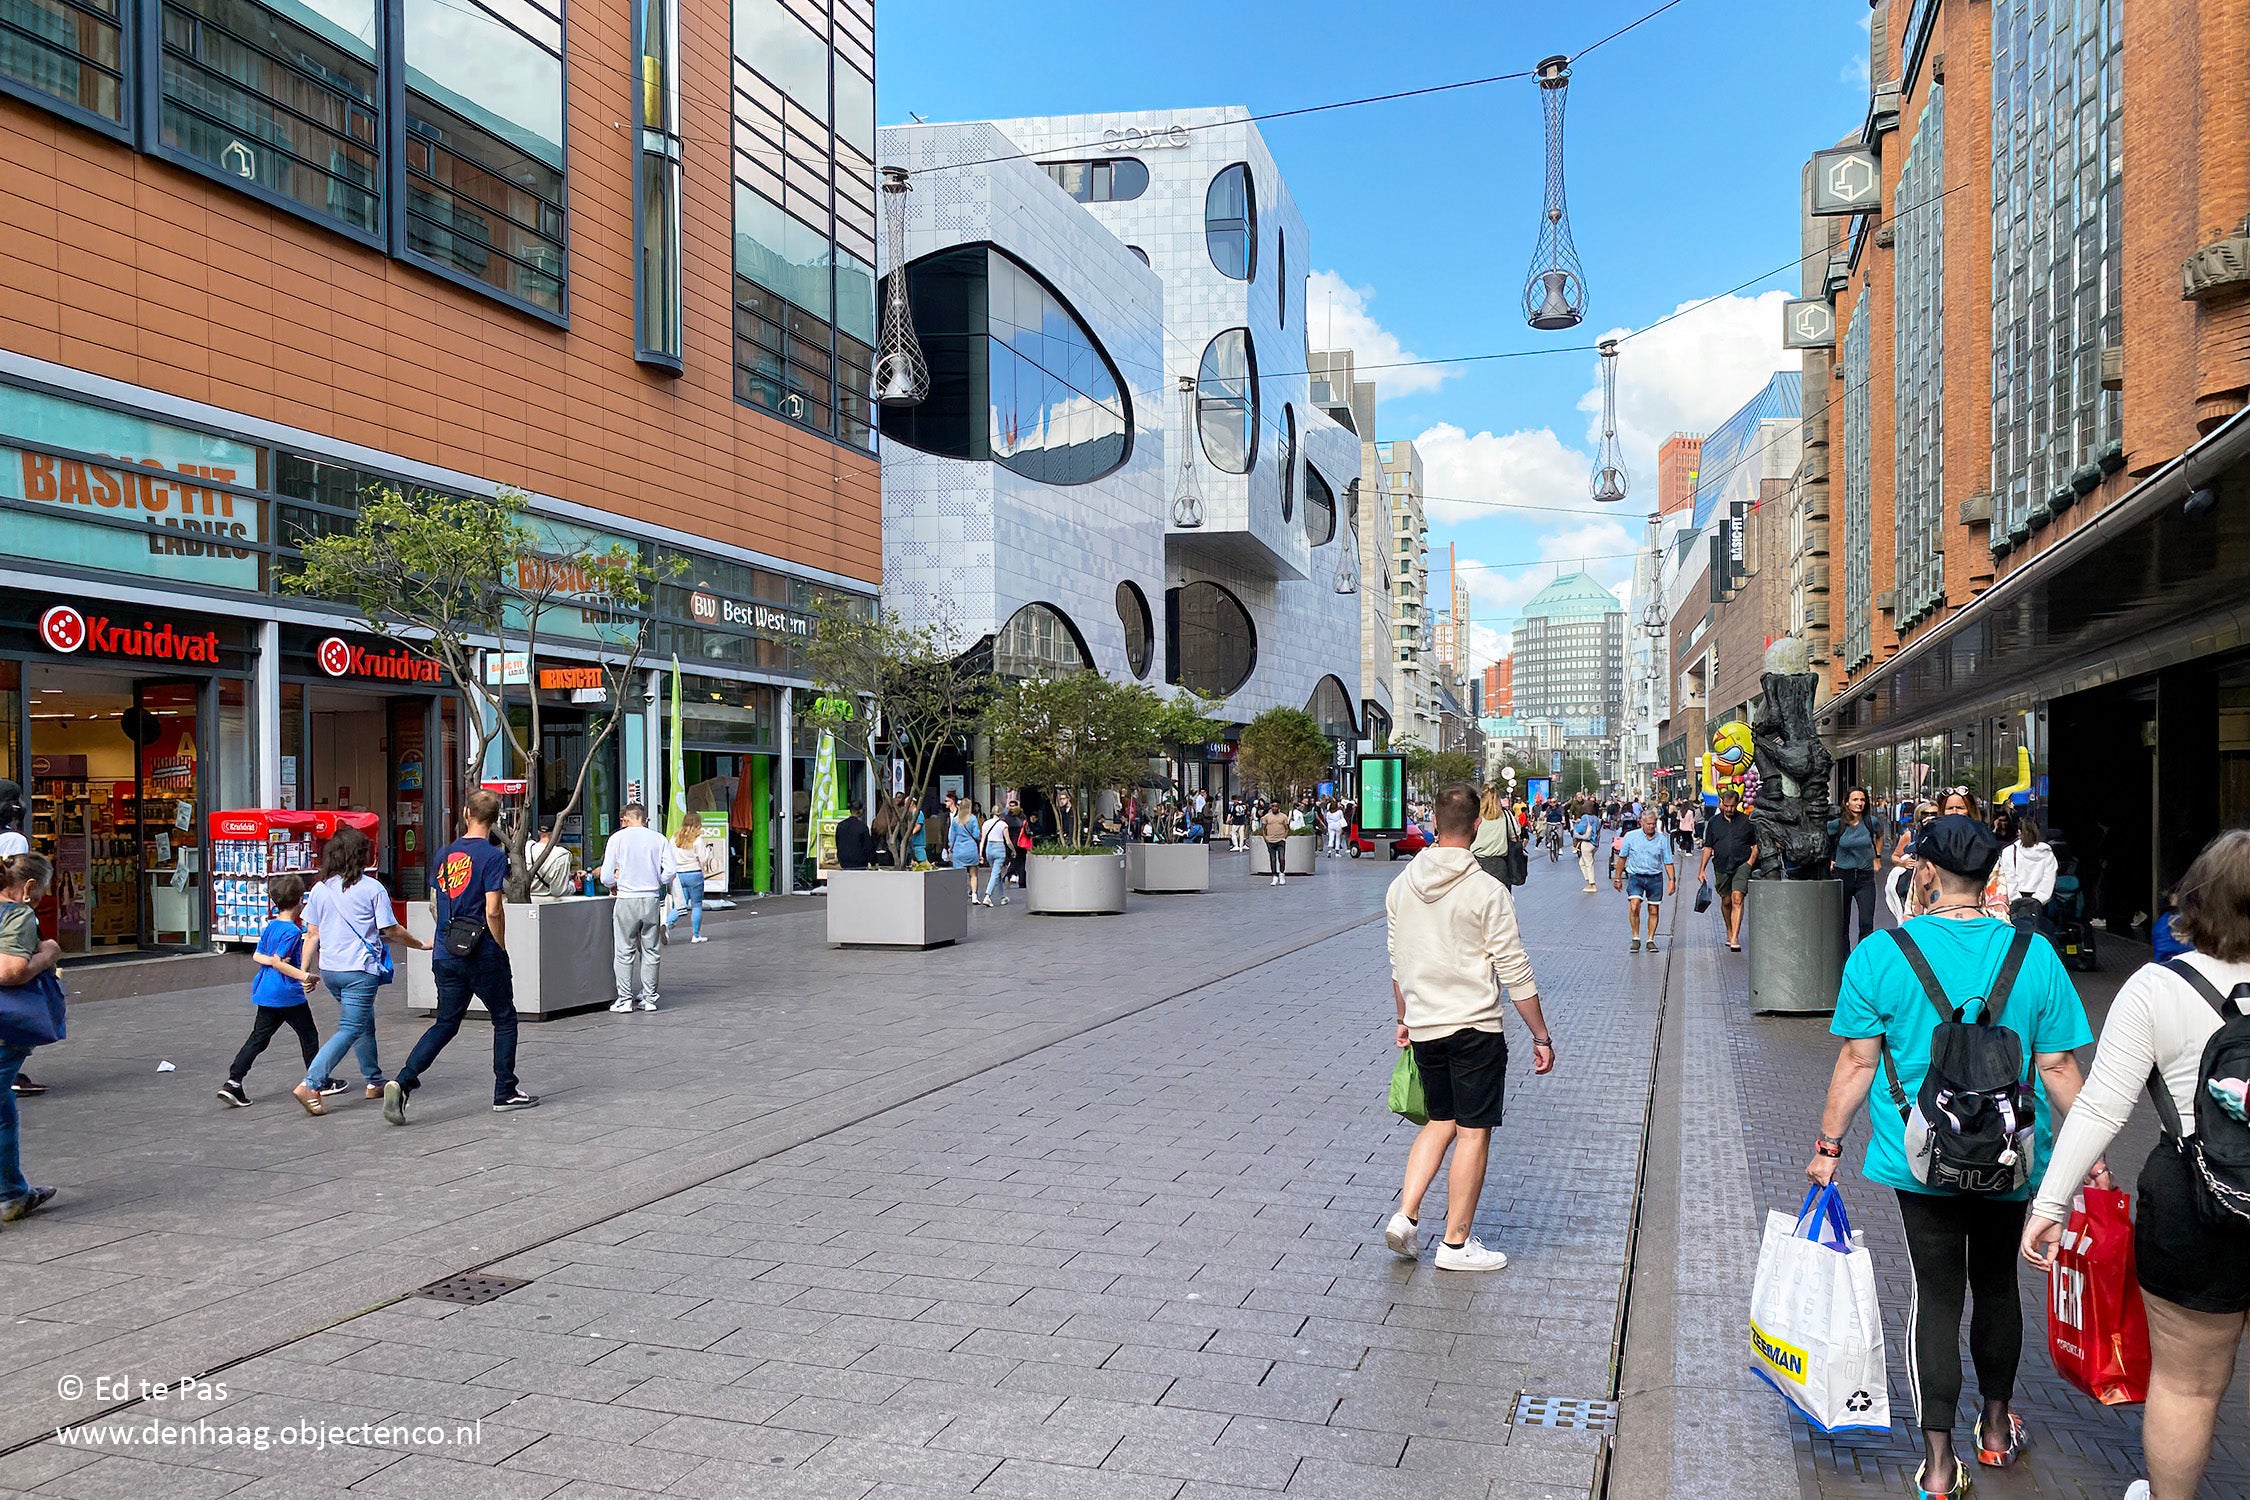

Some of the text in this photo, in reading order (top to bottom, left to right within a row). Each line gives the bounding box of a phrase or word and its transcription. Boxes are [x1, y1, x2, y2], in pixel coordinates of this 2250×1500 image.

[22, 450, 236, 518] BASIC-FIT
[148, 516, 249, 560] LADIES
[694, 595, 715, 618] BW
[723, 600, 753, 626] Best
[87, 616, 220, 664] Kruidvat
[349, 645, 442, 683] Kruidvat
[700, 826, 721, 837] osa
[1937, 1162, 2011, 1191] FILA
[1751, 1326, 1802, 1375] EEMAN
